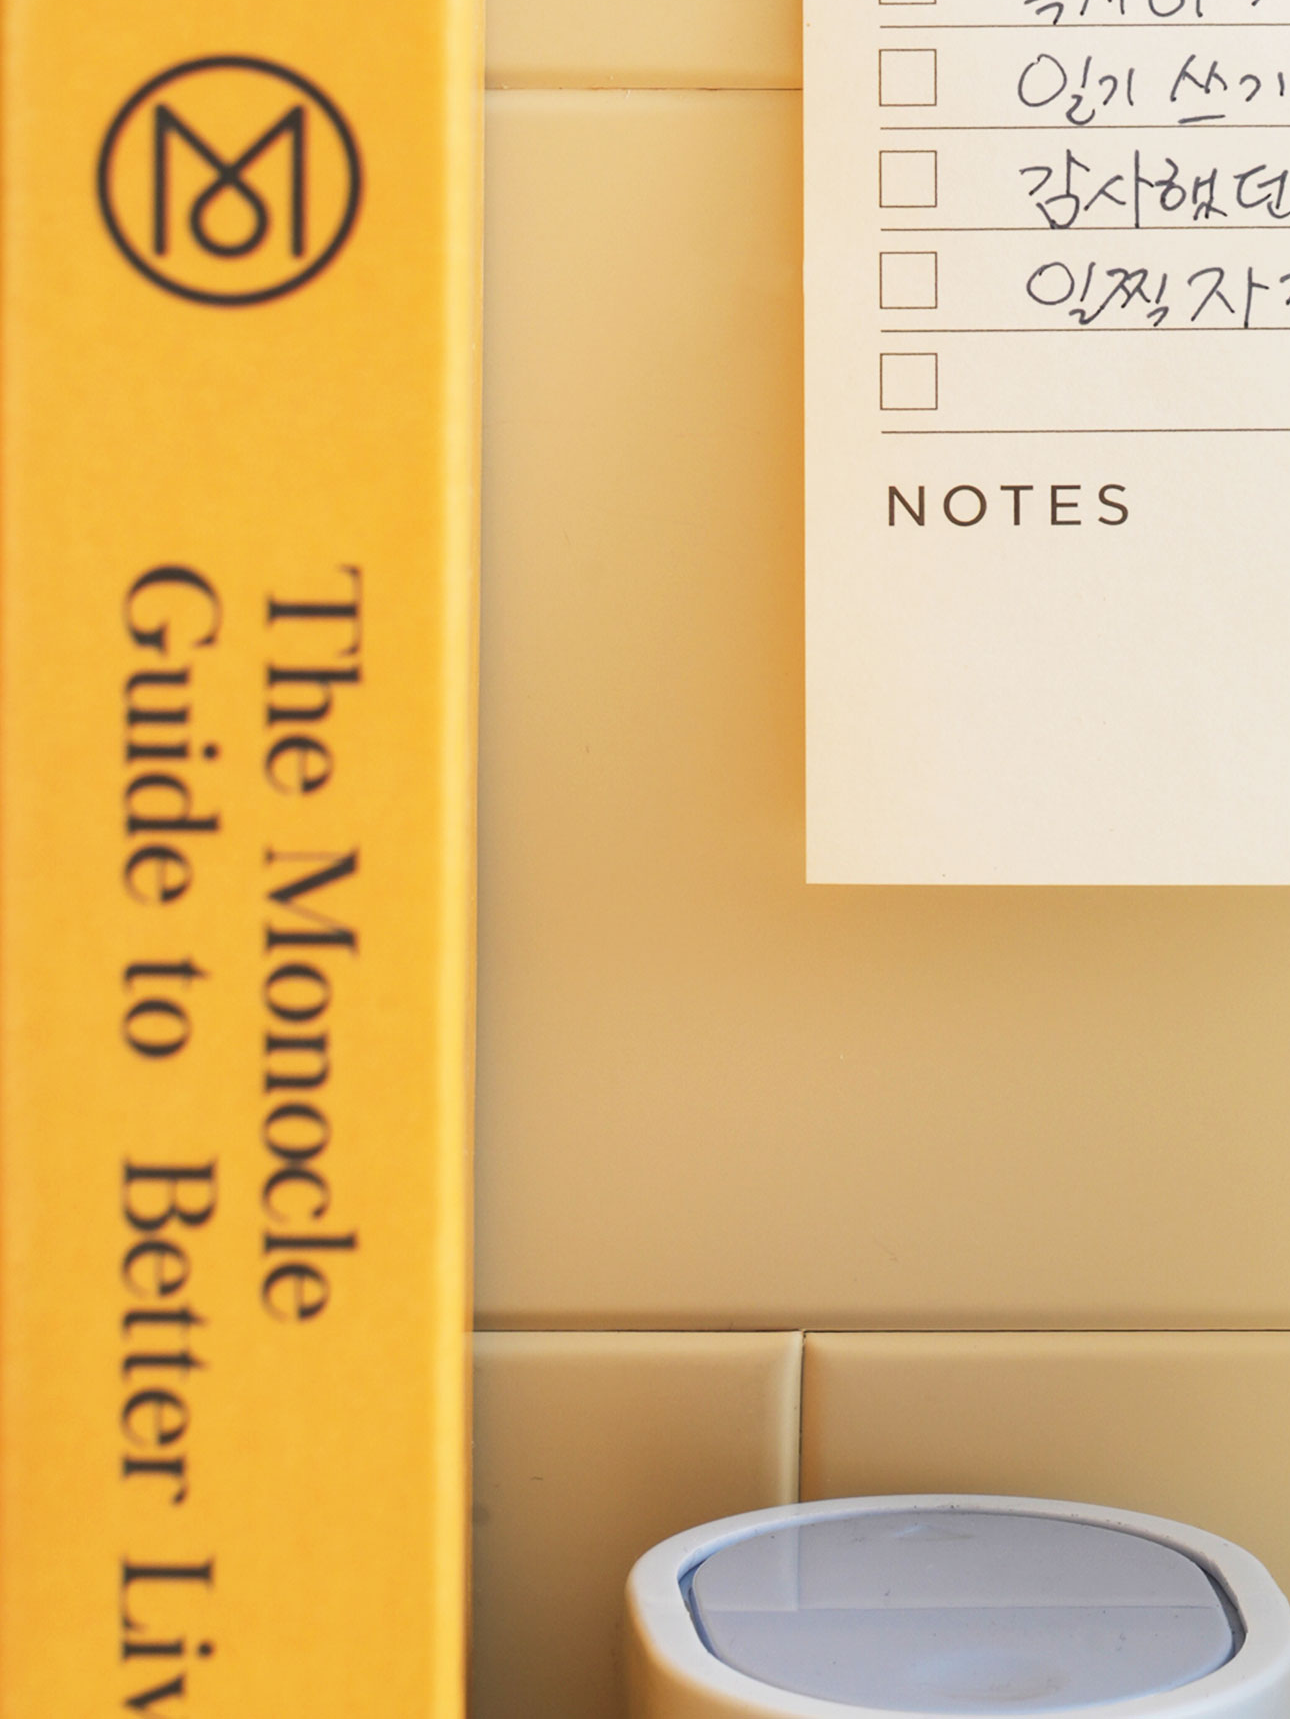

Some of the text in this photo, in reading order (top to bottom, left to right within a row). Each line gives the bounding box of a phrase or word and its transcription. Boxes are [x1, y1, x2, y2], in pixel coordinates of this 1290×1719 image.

[1017, 53, 1286, 125] 일기 쓰기
[888, 483, 1129, 527] NOTES
[122, 562, 222, 905] Guide
[122, 957, 208, 1059] to
[261, 562, 364, 1323] The Monocle
[120, 1155, 218, 1506] Better
